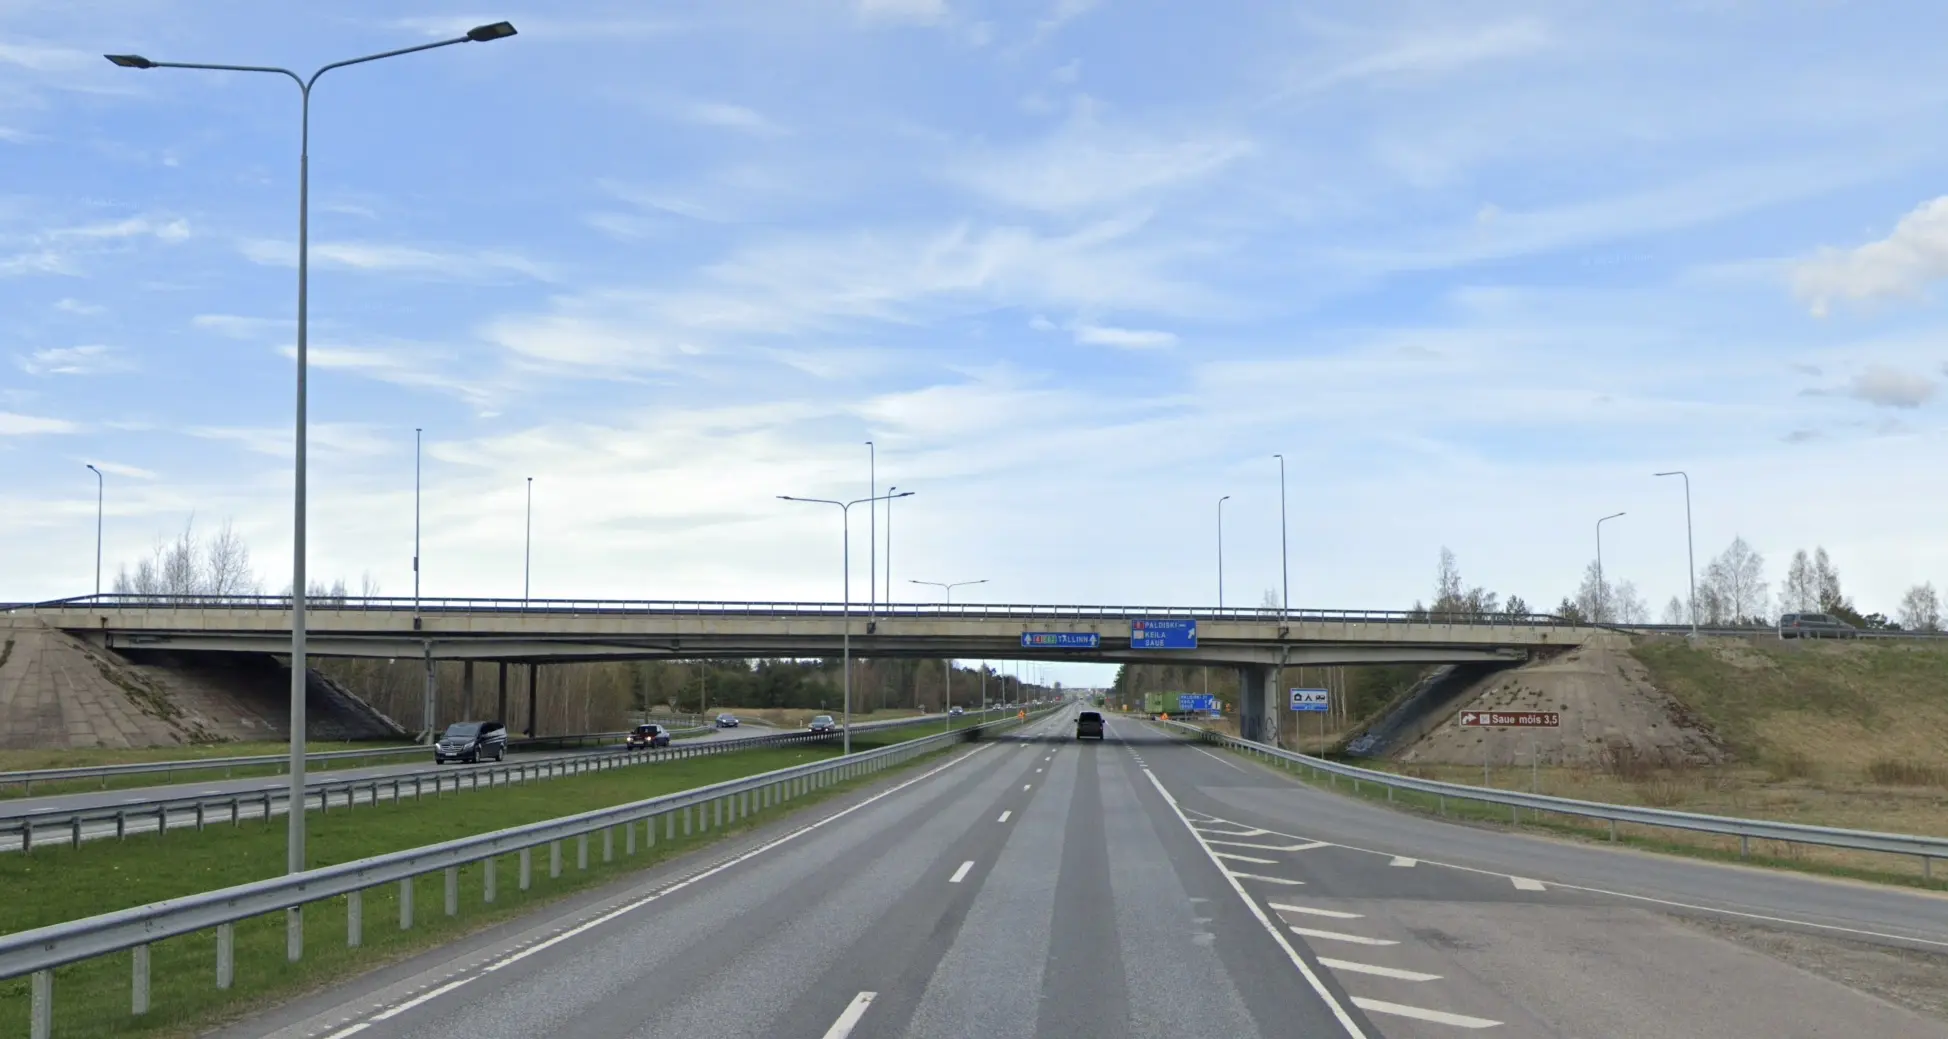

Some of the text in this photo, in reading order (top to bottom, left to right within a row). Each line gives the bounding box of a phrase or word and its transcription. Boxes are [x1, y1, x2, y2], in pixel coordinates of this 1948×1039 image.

[1145, 621, 1178, 629] PALDISKI
[1058, 635, 1089, 643] TALLINN
[1145, 631, 1166, 639] KEILA
[1492, 714, 1558, 725] Saue mõis 3,5
